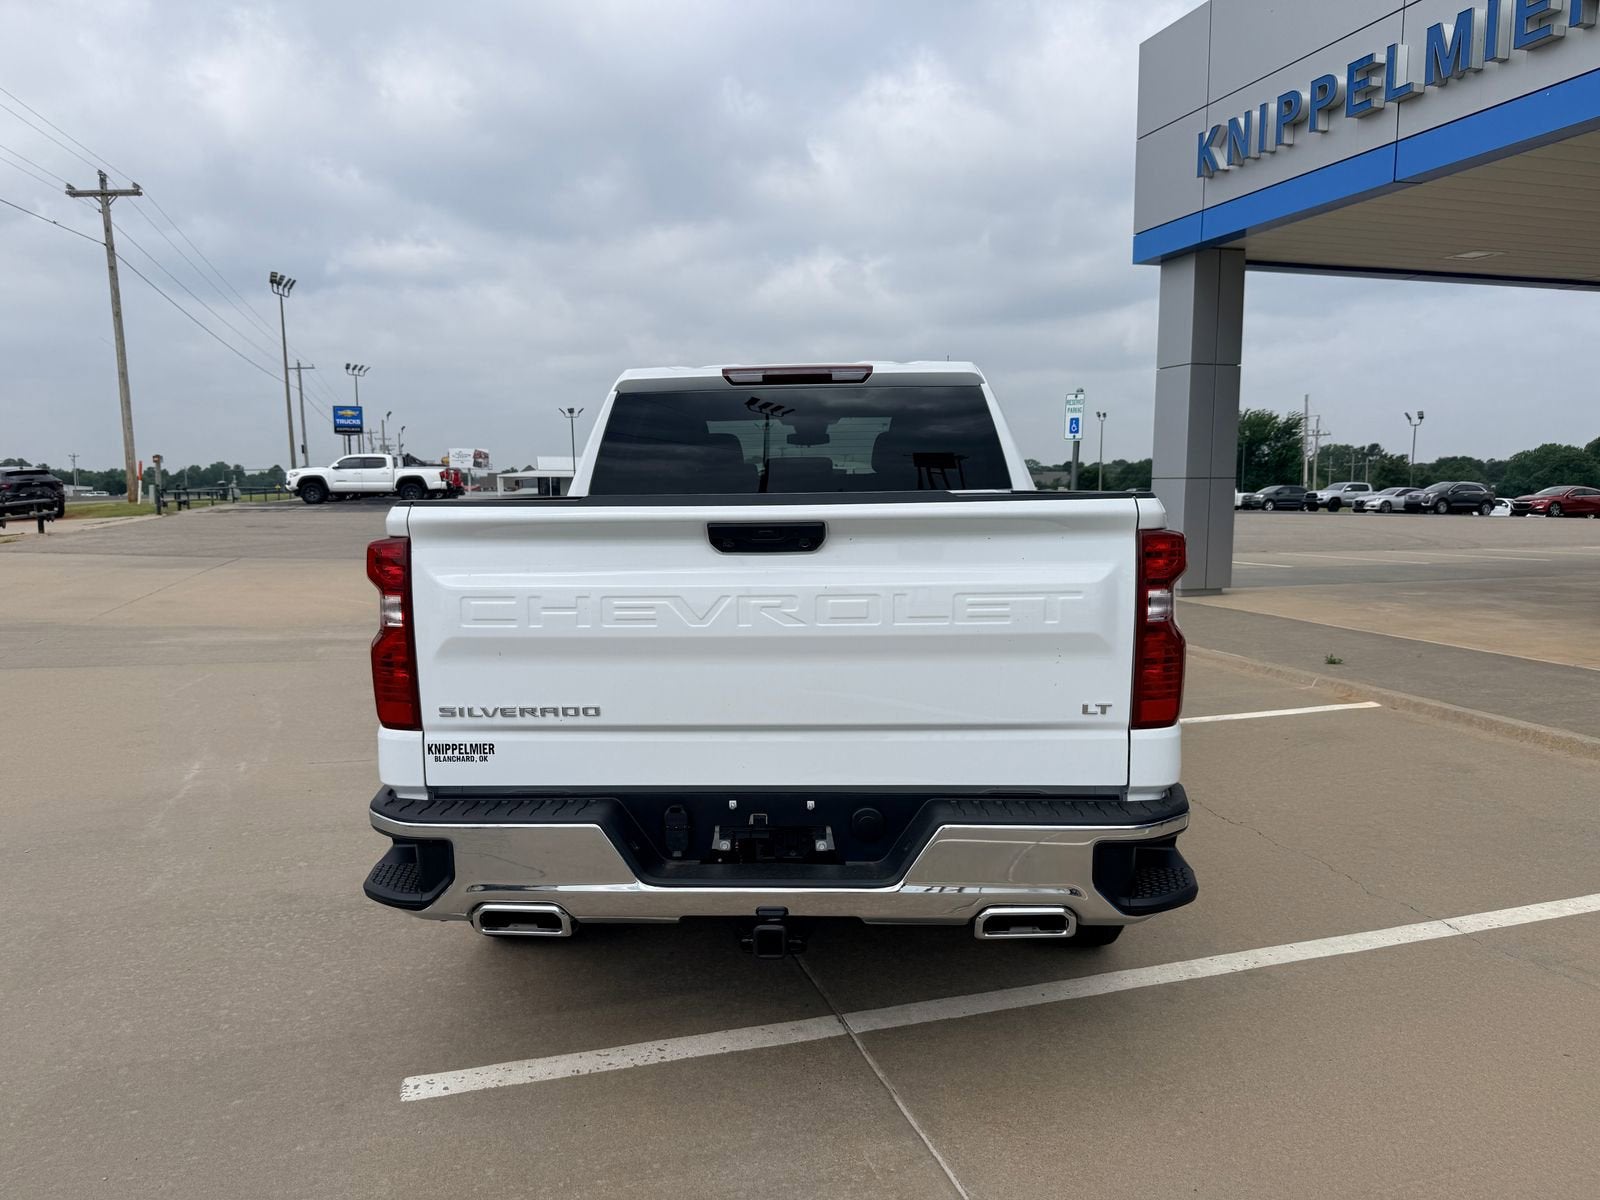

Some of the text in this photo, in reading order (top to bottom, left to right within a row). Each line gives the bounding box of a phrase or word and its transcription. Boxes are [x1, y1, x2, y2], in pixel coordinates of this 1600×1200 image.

[459, 590, 1083, 628] CHEVROLET
[438, 706, 601, 718] SILVERADO
[1082, 703, 1112, 715] LT
[427, 743, 495, 755] KNIPPELMIER
[434, 755, 489, 763] BLANCHARD, OK
